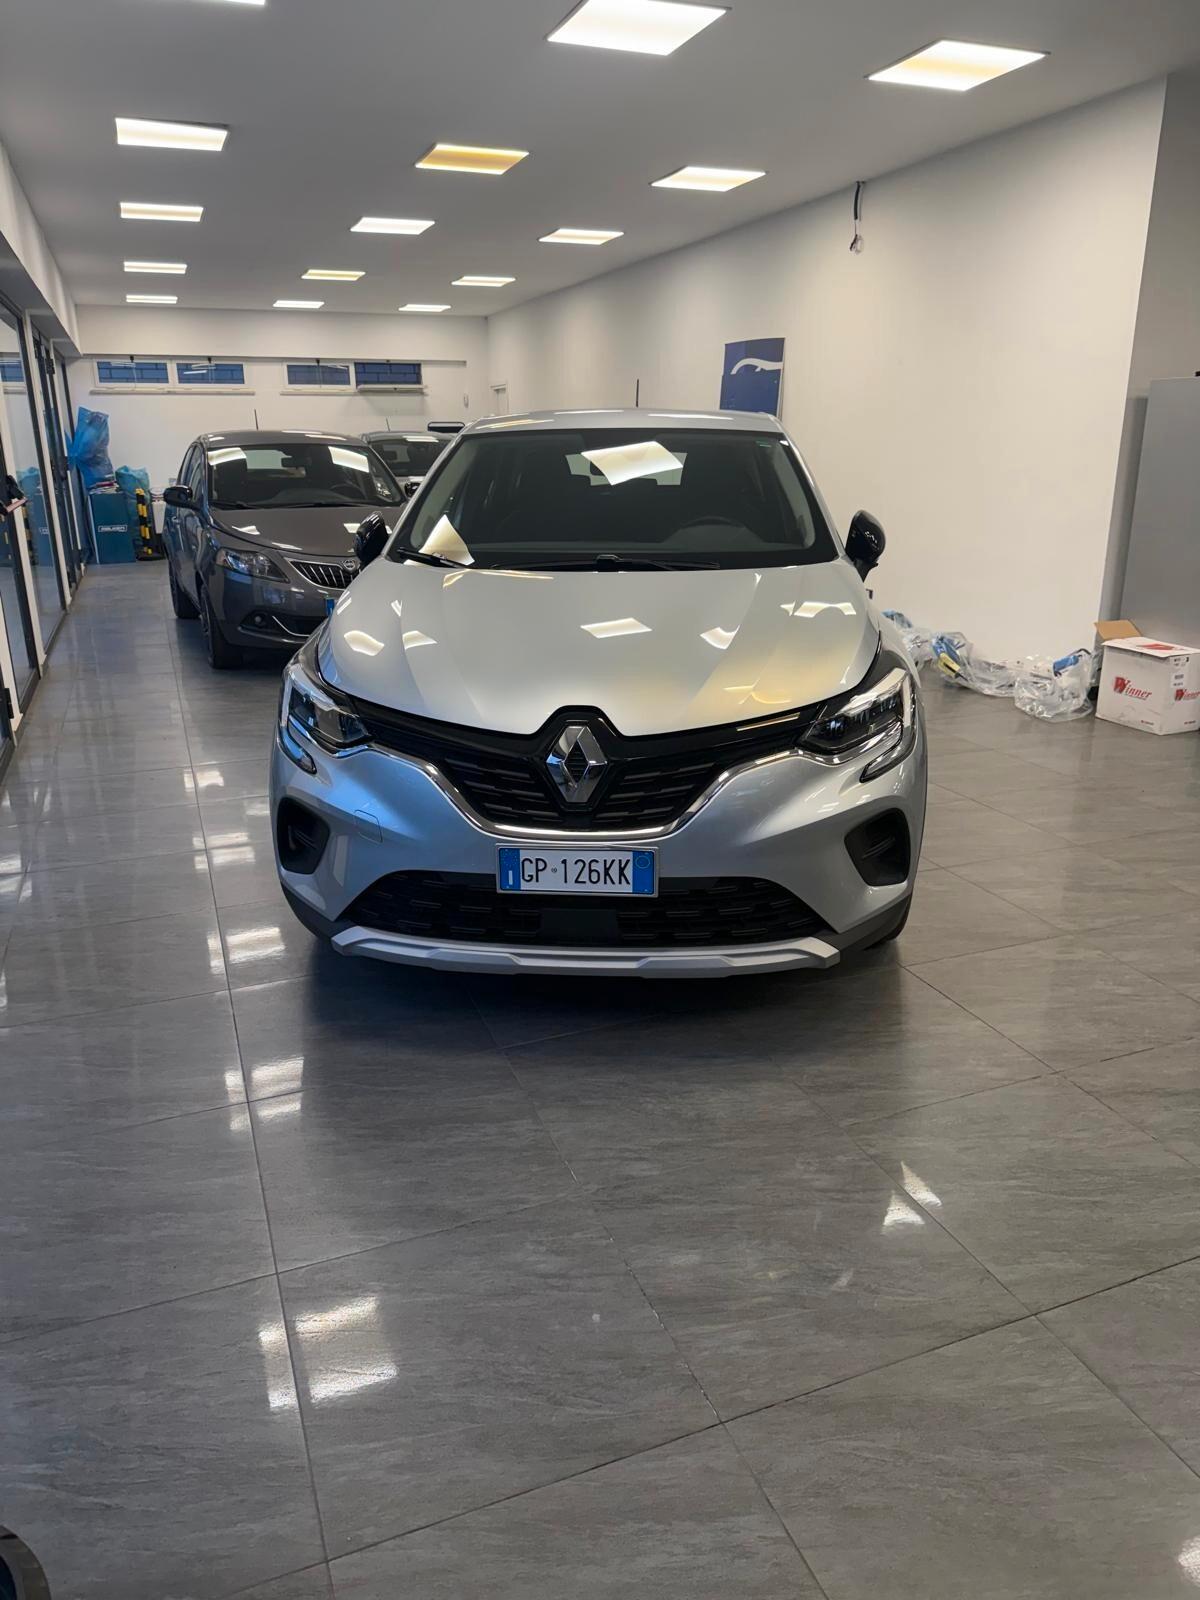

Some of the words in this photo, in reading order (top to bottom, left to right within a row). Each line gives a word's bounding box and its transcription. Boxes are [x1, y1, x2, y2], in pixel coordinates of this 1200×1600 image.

[1114, 677, 1152, 698] Winner
[521, 858, 547, 883] GP
[561, 859, 631, 885] 126KK
